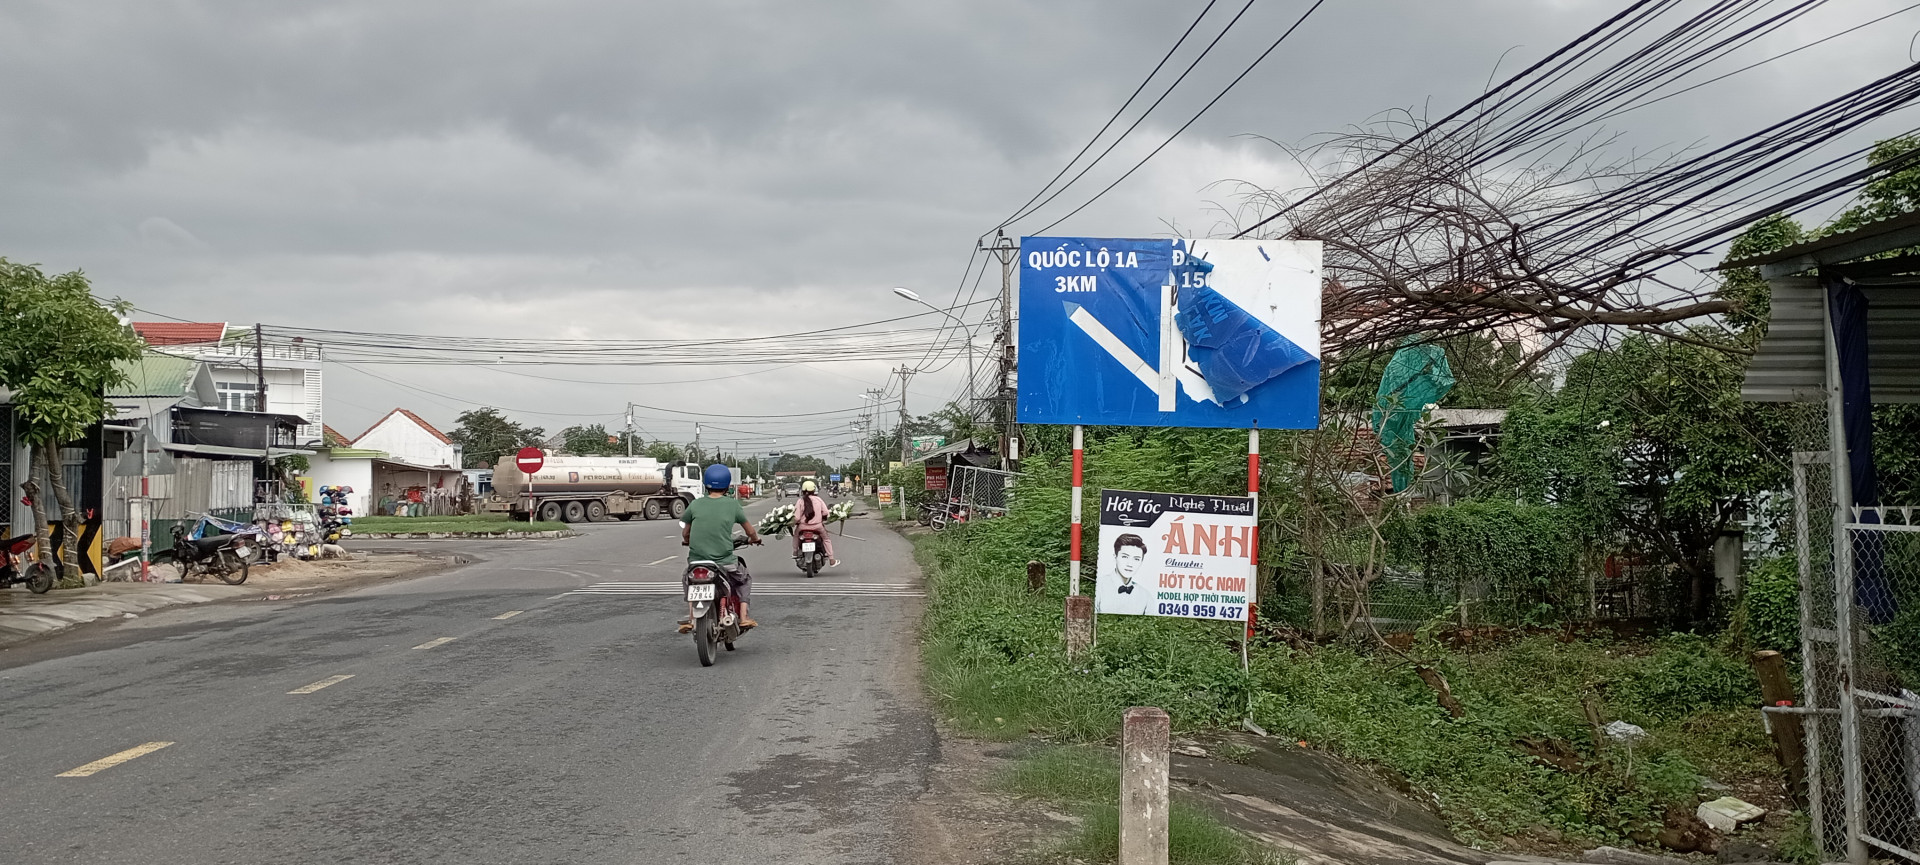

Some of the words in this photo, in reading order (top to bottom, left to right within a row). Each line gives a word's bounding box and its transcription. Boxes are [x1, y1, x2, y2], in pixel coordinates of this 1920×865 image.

[1028, 243, 1081, 271] QUỐC
[1086, 247, 1110, 272] LỘ
[1115, 251, 1139, 268] 1A
[1054, 275, 1097, 293] 3KM
[1106, 495, 1133, 512] Hớt
[1137, 498, 1161, 514] Tóc
[1169, 496, 1205, 512] Nghệ
[1210, 498, 1250, 512] Thuật
[1161, 515, 1250, 558] ÁNH
[1158, 570, 1185, 589] HỚT
[1189, 572, 1213, 591] TÓC
[1216, 576, 1246, 592] NAM
[1157, 591, 1182, 601] MODEL
[1183, 592, 1199, 603] HỢP
[1201, 592, 1219, 603] THỜI
[1220, 594, 1246, 604] TRANG
[1158, 602, 1189, 616] 0349
[1193, 604, 1216, 618] 959
[1219, 606, 1243, 619] 437
